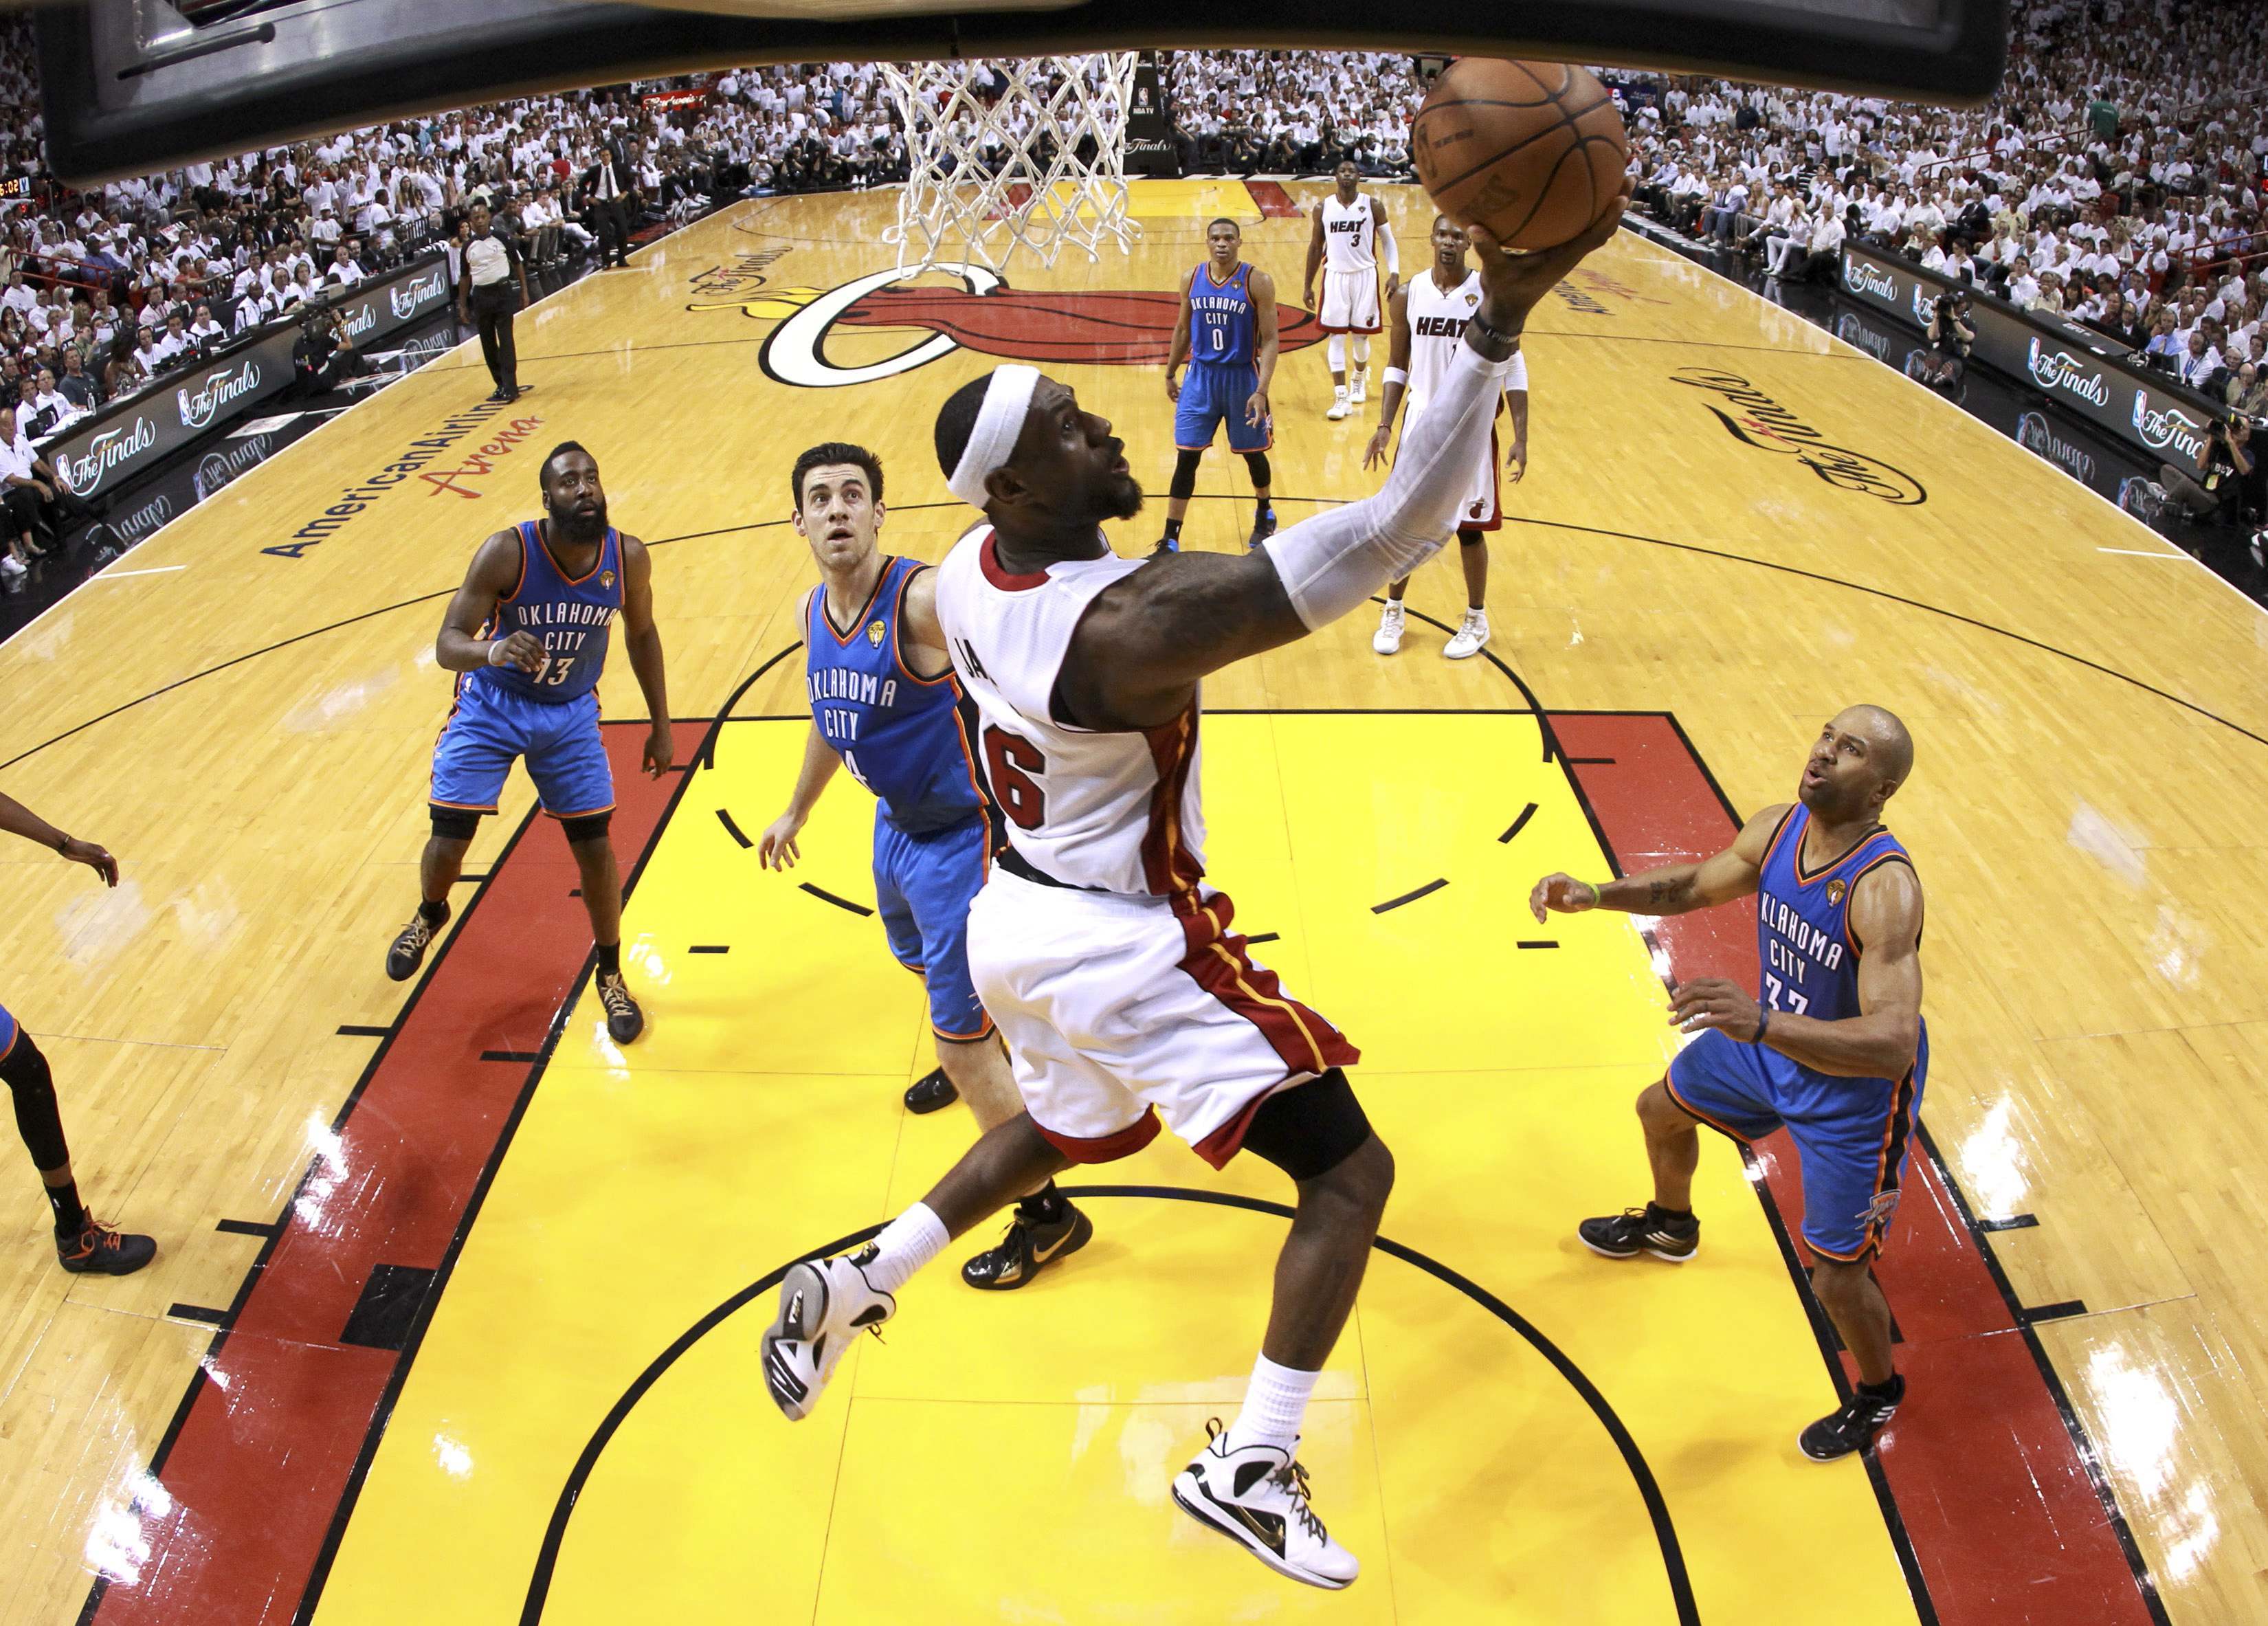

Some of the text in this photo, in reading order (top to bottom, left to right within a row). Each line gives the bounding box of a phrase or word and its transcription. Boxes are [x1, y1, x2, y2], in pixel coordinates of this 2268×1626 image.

[1129, 138, 1172, 154] Finals
[1331, 217, 1367, 233] HEAT
[1350, 234, 1361, 247] 3
[408, 272, 445, 319] Finals
[1860, 263, 1898, 300] Finals
[344, 304, 377, 336] inals
[1190, 296, 1247, 315] OKLAHOMA
[1205, 313, 1228, 325] CITY
[1212, 328, 1223, 351] 0
[1416, 315, 1474, 338] HEAT
[190, 360, 260, 427] The Finals
[2037, 351, 2109, 407] The Finals
[2142, 408, 2205, 460] The Fina
[72, 416, 156, 496] The Finals
[260, 385, 535, 558] AmericanAirlin
[418, 414, 545, 499] Arena
[518, 602, 617, 627] OKLAHOMA
[545, 631, 586, 651] CITY
[533, 656, 575, 686] 13
[807, 667, 896, 707] OKLAHOMA
[825, 709, 858, 742] CITY
[983, 723, 1045, 832] 6
[1761, 891, 1843, 970] KLAHOMA
[1770, 939, 1805, 984] CITY
